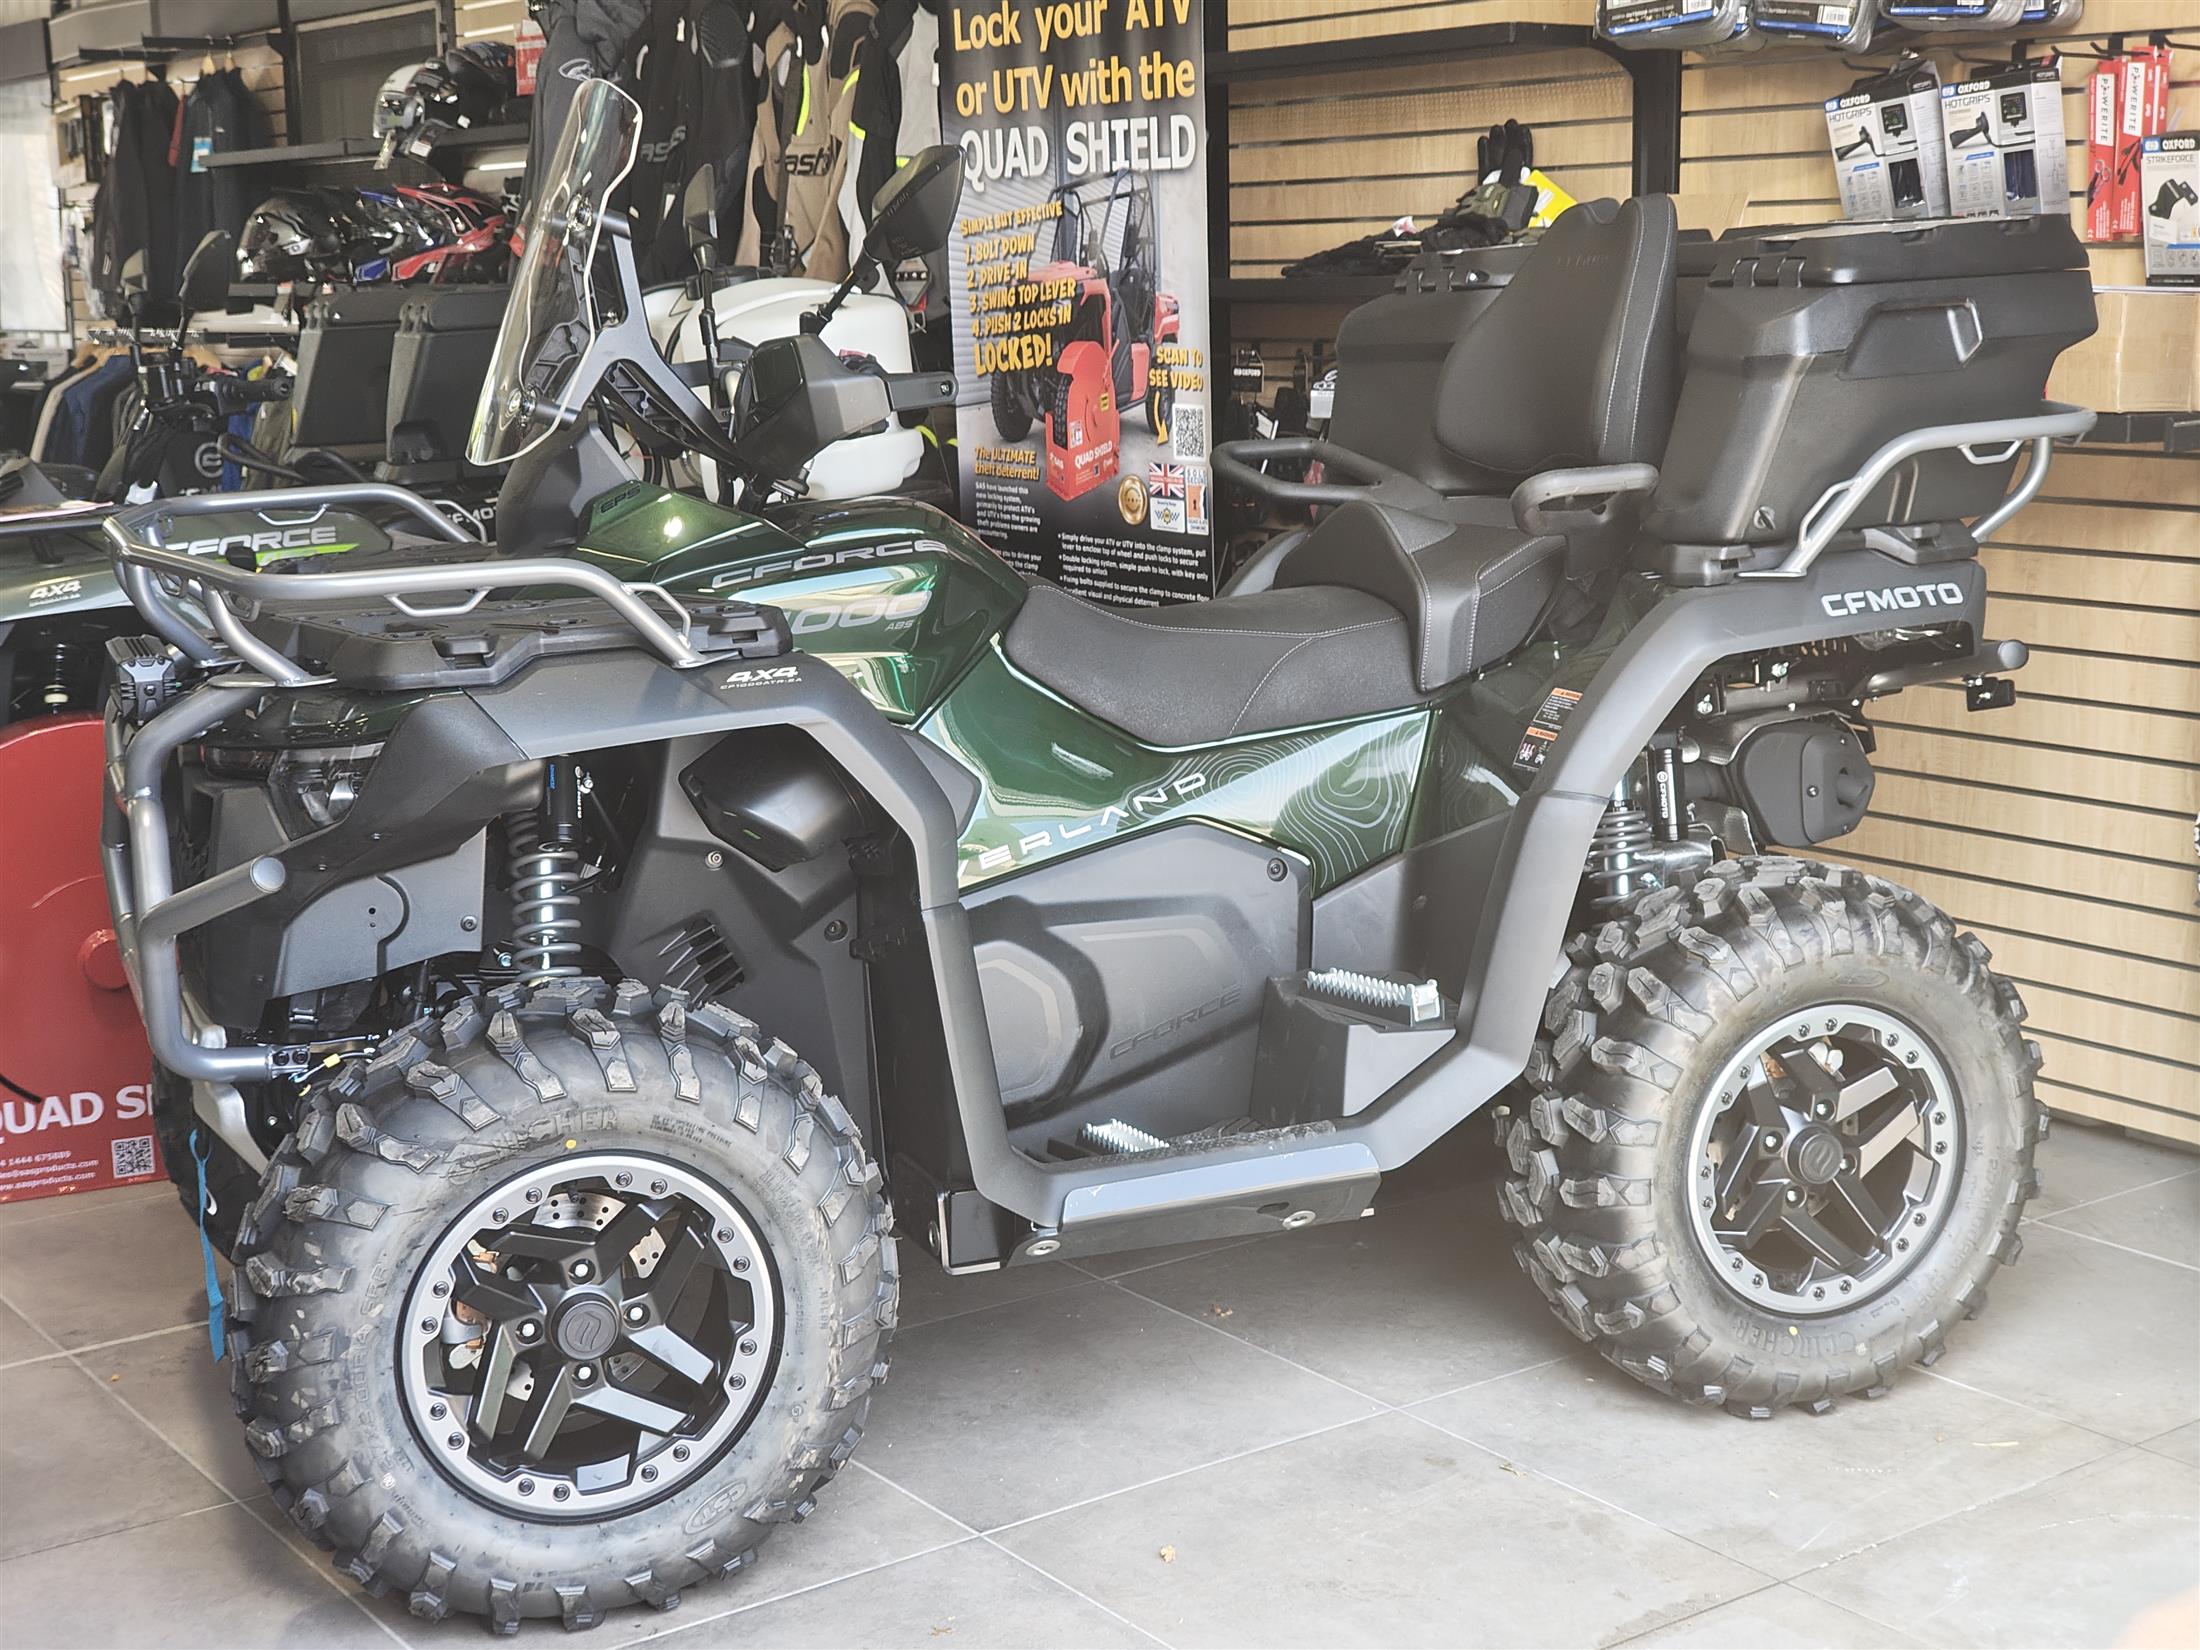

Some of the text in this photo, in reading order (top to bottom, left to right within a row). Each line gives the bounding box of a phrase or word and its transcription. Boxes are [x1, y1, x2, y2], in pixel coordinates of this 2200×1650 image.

[954, 0, 1191, 52] Lock your ATV
[956, 51, 1195, 117] or UTV with the
[1957, 80, 1991, 94] OXFORD
[1840, 94, 1870, 108] OXFORD
[1944, 94, 1991, 109] HOTGRIPS
[1829, 107, 1872, 122] HOTGRIPS
[960, 114, 1197, 192] QUAD SHIELD
[2162, 138, 2195, 150] OXFORD
[960, 200, 1063, 237] SIMPLE BUT EFFECTIVE
[976, 239, 1000, 264] BOLT
[1002, 233, 1035, 257] DOWN
[983, 286, 1016, 312] SWING
[1018, 283, 1038, 305] TOP
[1040, 278, 1076, 302] LEVER
[985, 312, 1011, 336] PUSH
[1013, 311, 1022, 331] 2
[1024, 306, 1056, 330] LOCKS
[1058, 303, 1072, 325] IN
[974, 333, 1053, 377] LOCKED!
[1156, 347, 1203, 368] SCAN TO
[1149, 369, 1203, 392] SEE VIDEO
[975, 447, 1036, 465] The ULTIMATE
[1075, 450, 1094, 469] QUAD
[1094, 440, 1113, 459] SHIELD
[975, 462, 1040, 480] theft deterrent!
[601, 484, 640, 513] EPS
[988, 492, 1002, 502] locking
[1019, 486, 1029, 495] this
[976, 501, 997, 512] primarily
[1004, 504, 1020, 513] protect
[1001, 511, 1011, 520] from
[1011, 513, 1020, 522] the
[1020, 516, 1041, 526] growing
[977, 518, 989, 527] theft
[990, 520, 1010, 530] problems
[1011, 523, 1029, 531] owners
[1017, 551, 1030, 559] drive
[1031, 553, 1041, 561] your
[1062, 532, 1079, 542] Simply
[1080, 534, 1094, 543] drive
[1094, 537, 1105, 545] your
[1106, 537, 1115, 546] ATV
[1122, 540, 1133, 549] UTV
[1134, 542, 1146, 550] into
[1146, 543, 1155, 552] the
[1156, 545, 1171, 554] clamp
[1172, 547, 1194, 557] system,
[1195, 549, 1206, 558] pull
[1062, 543, 1074, 551] lever
[1083, 545, 1101, 553] enclose
[1102, 547, 1110, 555] top
[1117, 549, 1132, 558] wheel
[1133, 551, 1144, 559] and
[1145, 553, 1157, 562] push
[1158, 554, 1171, 562] locks
[1172, 556, 1179, 564] to
[1179, 558, 1198, 566] secure
[712, 539, 948, 588] CFORCE
[1014, 560, 1024, 568] the
[1024, 561, 1038, 571] clamp
[1063, 555, 1080, 563] Double
[1081, 556, 1099, 567] locking
[1100, 560, 1118, 569] system,
[1119, 562, 1136, 571] simple
[1138, 565, 1150, 573] push
[1158, 567, 1170, 576] lock,
[1171, 569, 1183, 577] with
[1185, 571, 1195, 580] key
[1196, 572, 1208, 582] only
[1063, 564, 1108, 576] required to unlock
[1064, 575, 1079, 585] Fixing
[1080, 577, 1093, 586] bolts
[1094, 580, 1113, 589] supplied
[1114, 582, 1119, 590] to
[1120, 585, 1137, 593] secure
[1138, 585, 1148, 594] the
[1149, 587, 1164, 596] clamp
[1172, 591, 1196, 601] concrete
[1197, 593, 1210, 602] floor
[1088, 591, 1102, 599] visual
[1113, 595, 1133, 604] physical
[1134, 597, 1160, 607] deterrent
[1821, 582, 1964, 617] CFMOTO
[785, 590, 932, 634] 000
[884, 619, 915, 632] ABS
[1660, 782, 1669, 819] CFMOTO
[1110, 984, 1240, 1059] CFORCE
[0, 1084, 152, 1135] UAD S
